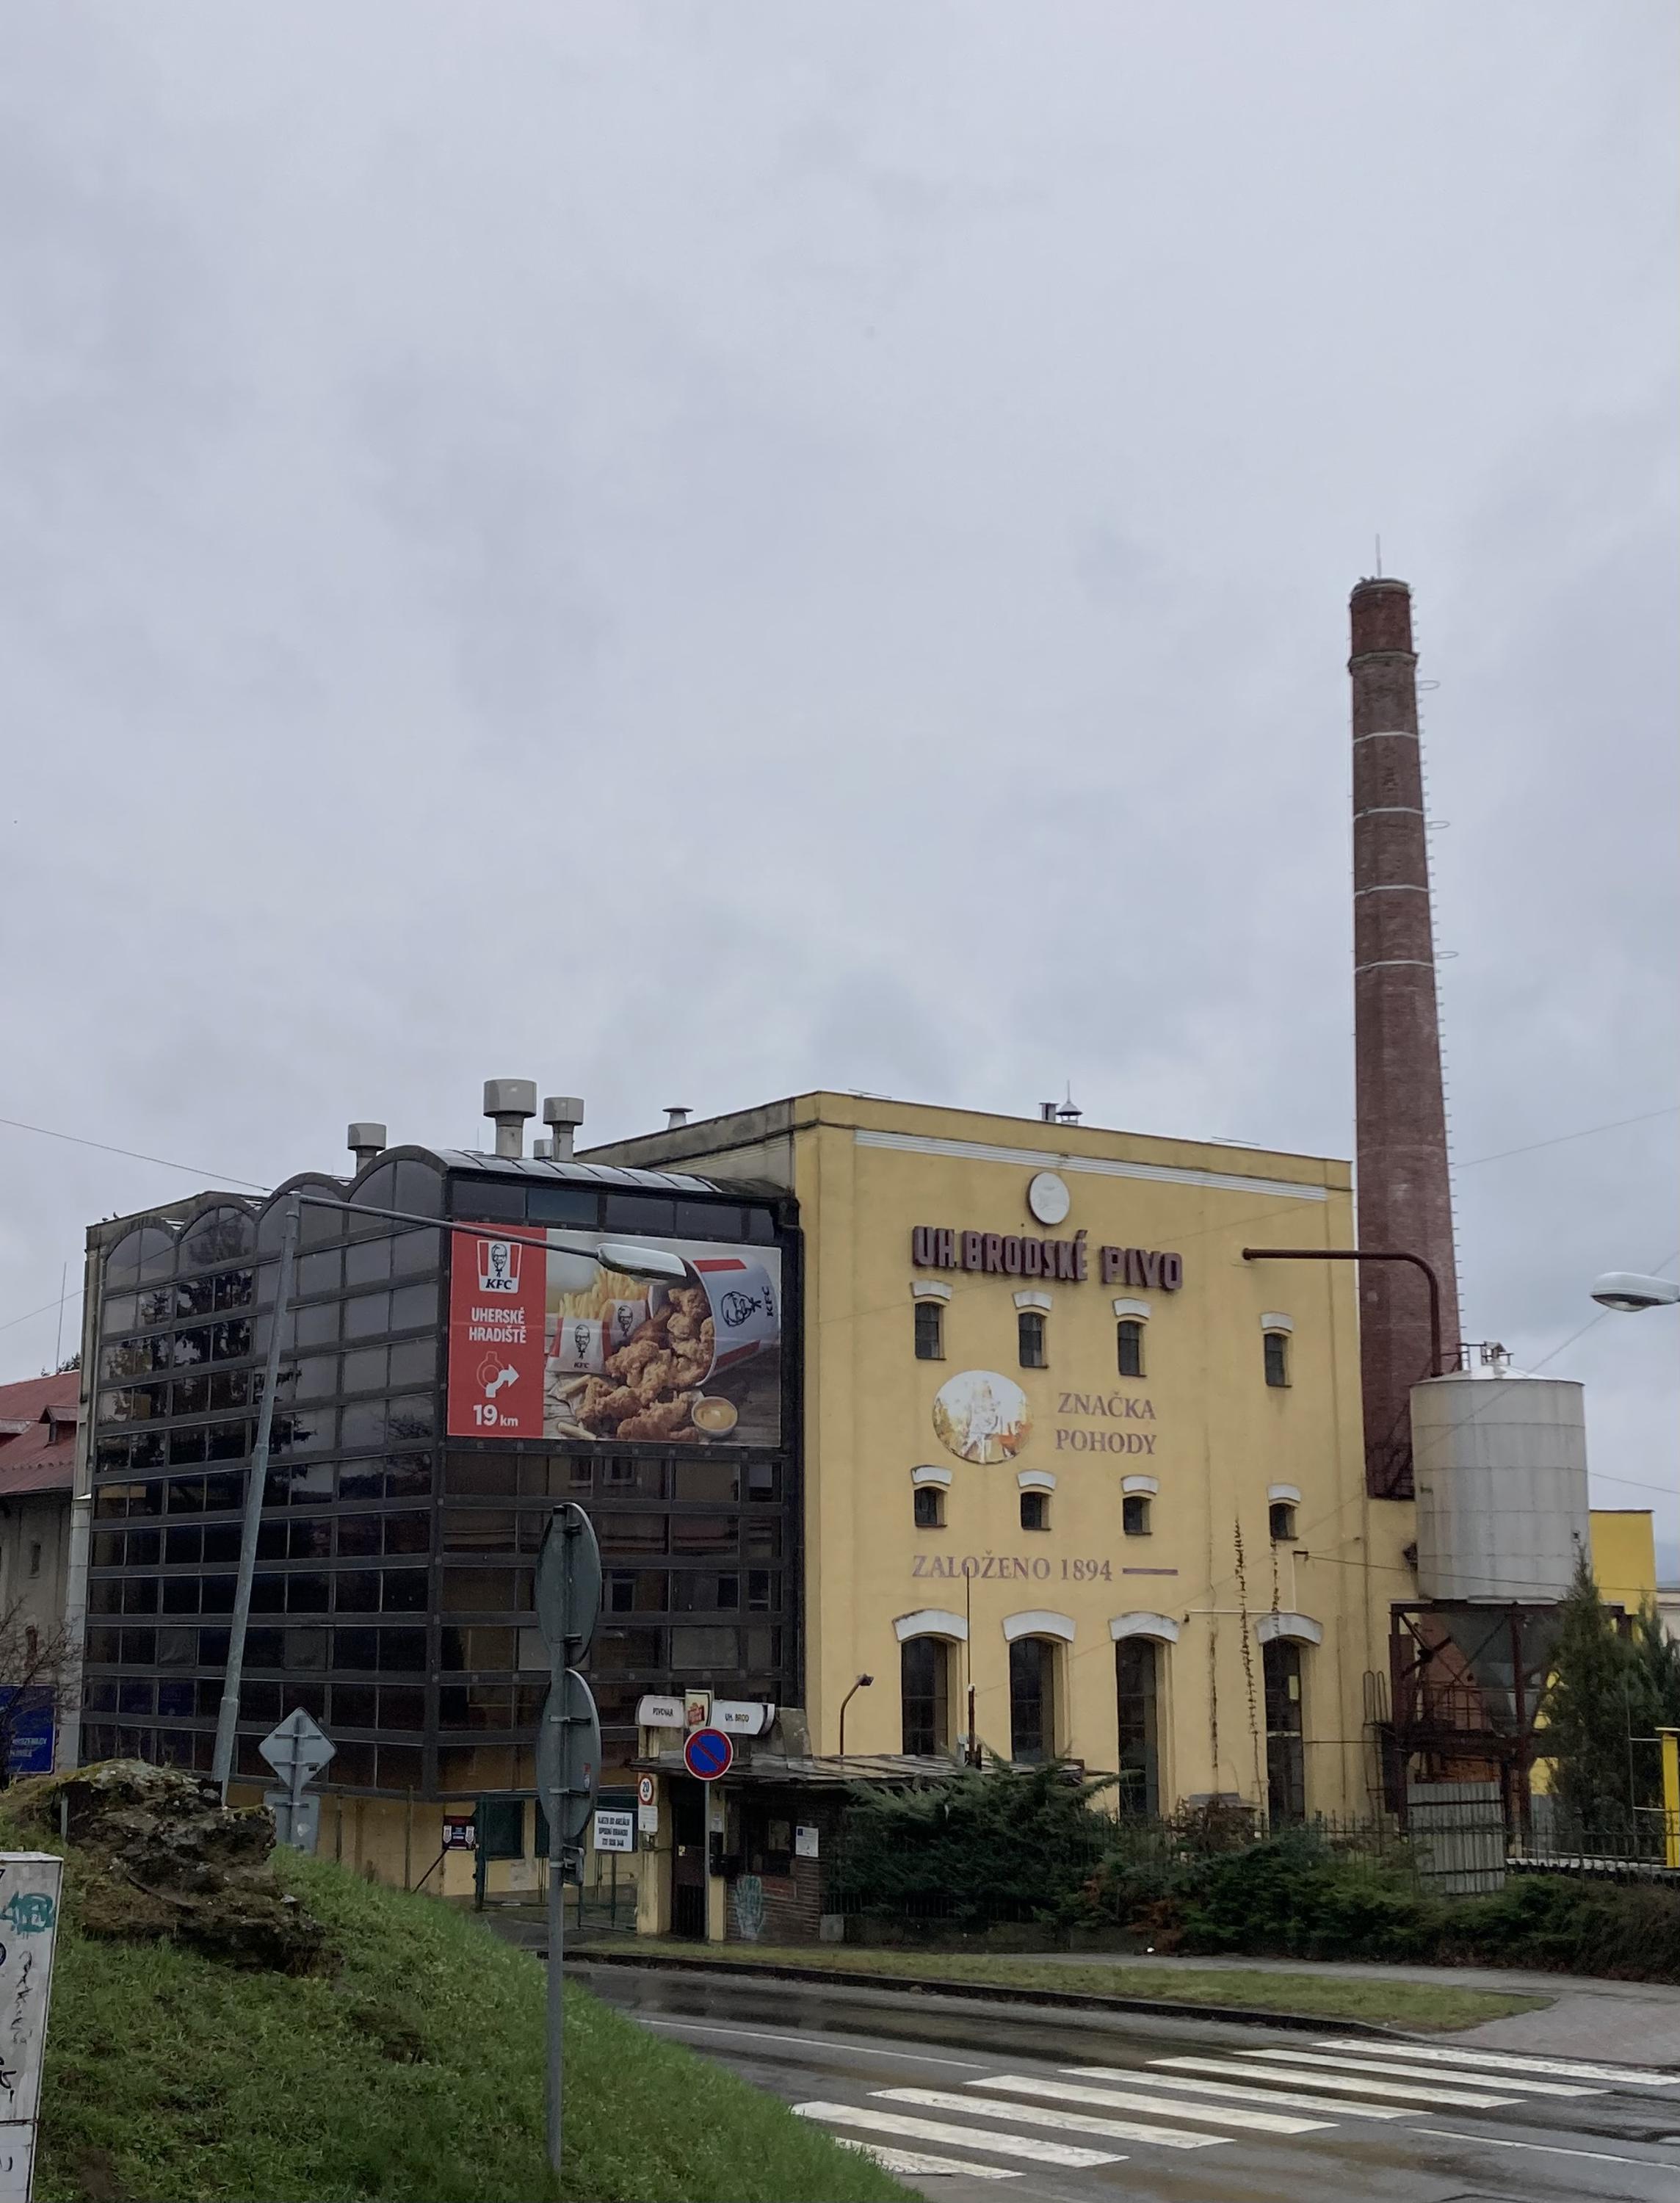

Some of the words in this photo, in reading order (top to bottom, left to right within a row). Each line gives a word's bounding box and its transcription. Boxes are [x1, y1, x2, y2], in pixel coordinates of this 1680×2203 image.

[1101, 1245, 1184, 1289] PIVO
[485, 1278, 513, 1289] KFC
[761, 1287, 773, 1317] KFC
[471, 1306, 526, 1325] UHERSKÉ
[468, 1325, 527, 1344] HRADIŠTĚ
[472, 1404, 499, 1426] 19
[500, 1416, 518, 1427] km
[1057, 1392, 1156, 1419] ZNAČKA
[1055, 1428, 1157, 1455] POHODY
[912, 1550, 1050, 1580] ZALOŽENO
[1061, 1559, 1112, 1581] 1894
[735, 1714, 750, 1722] BROD
